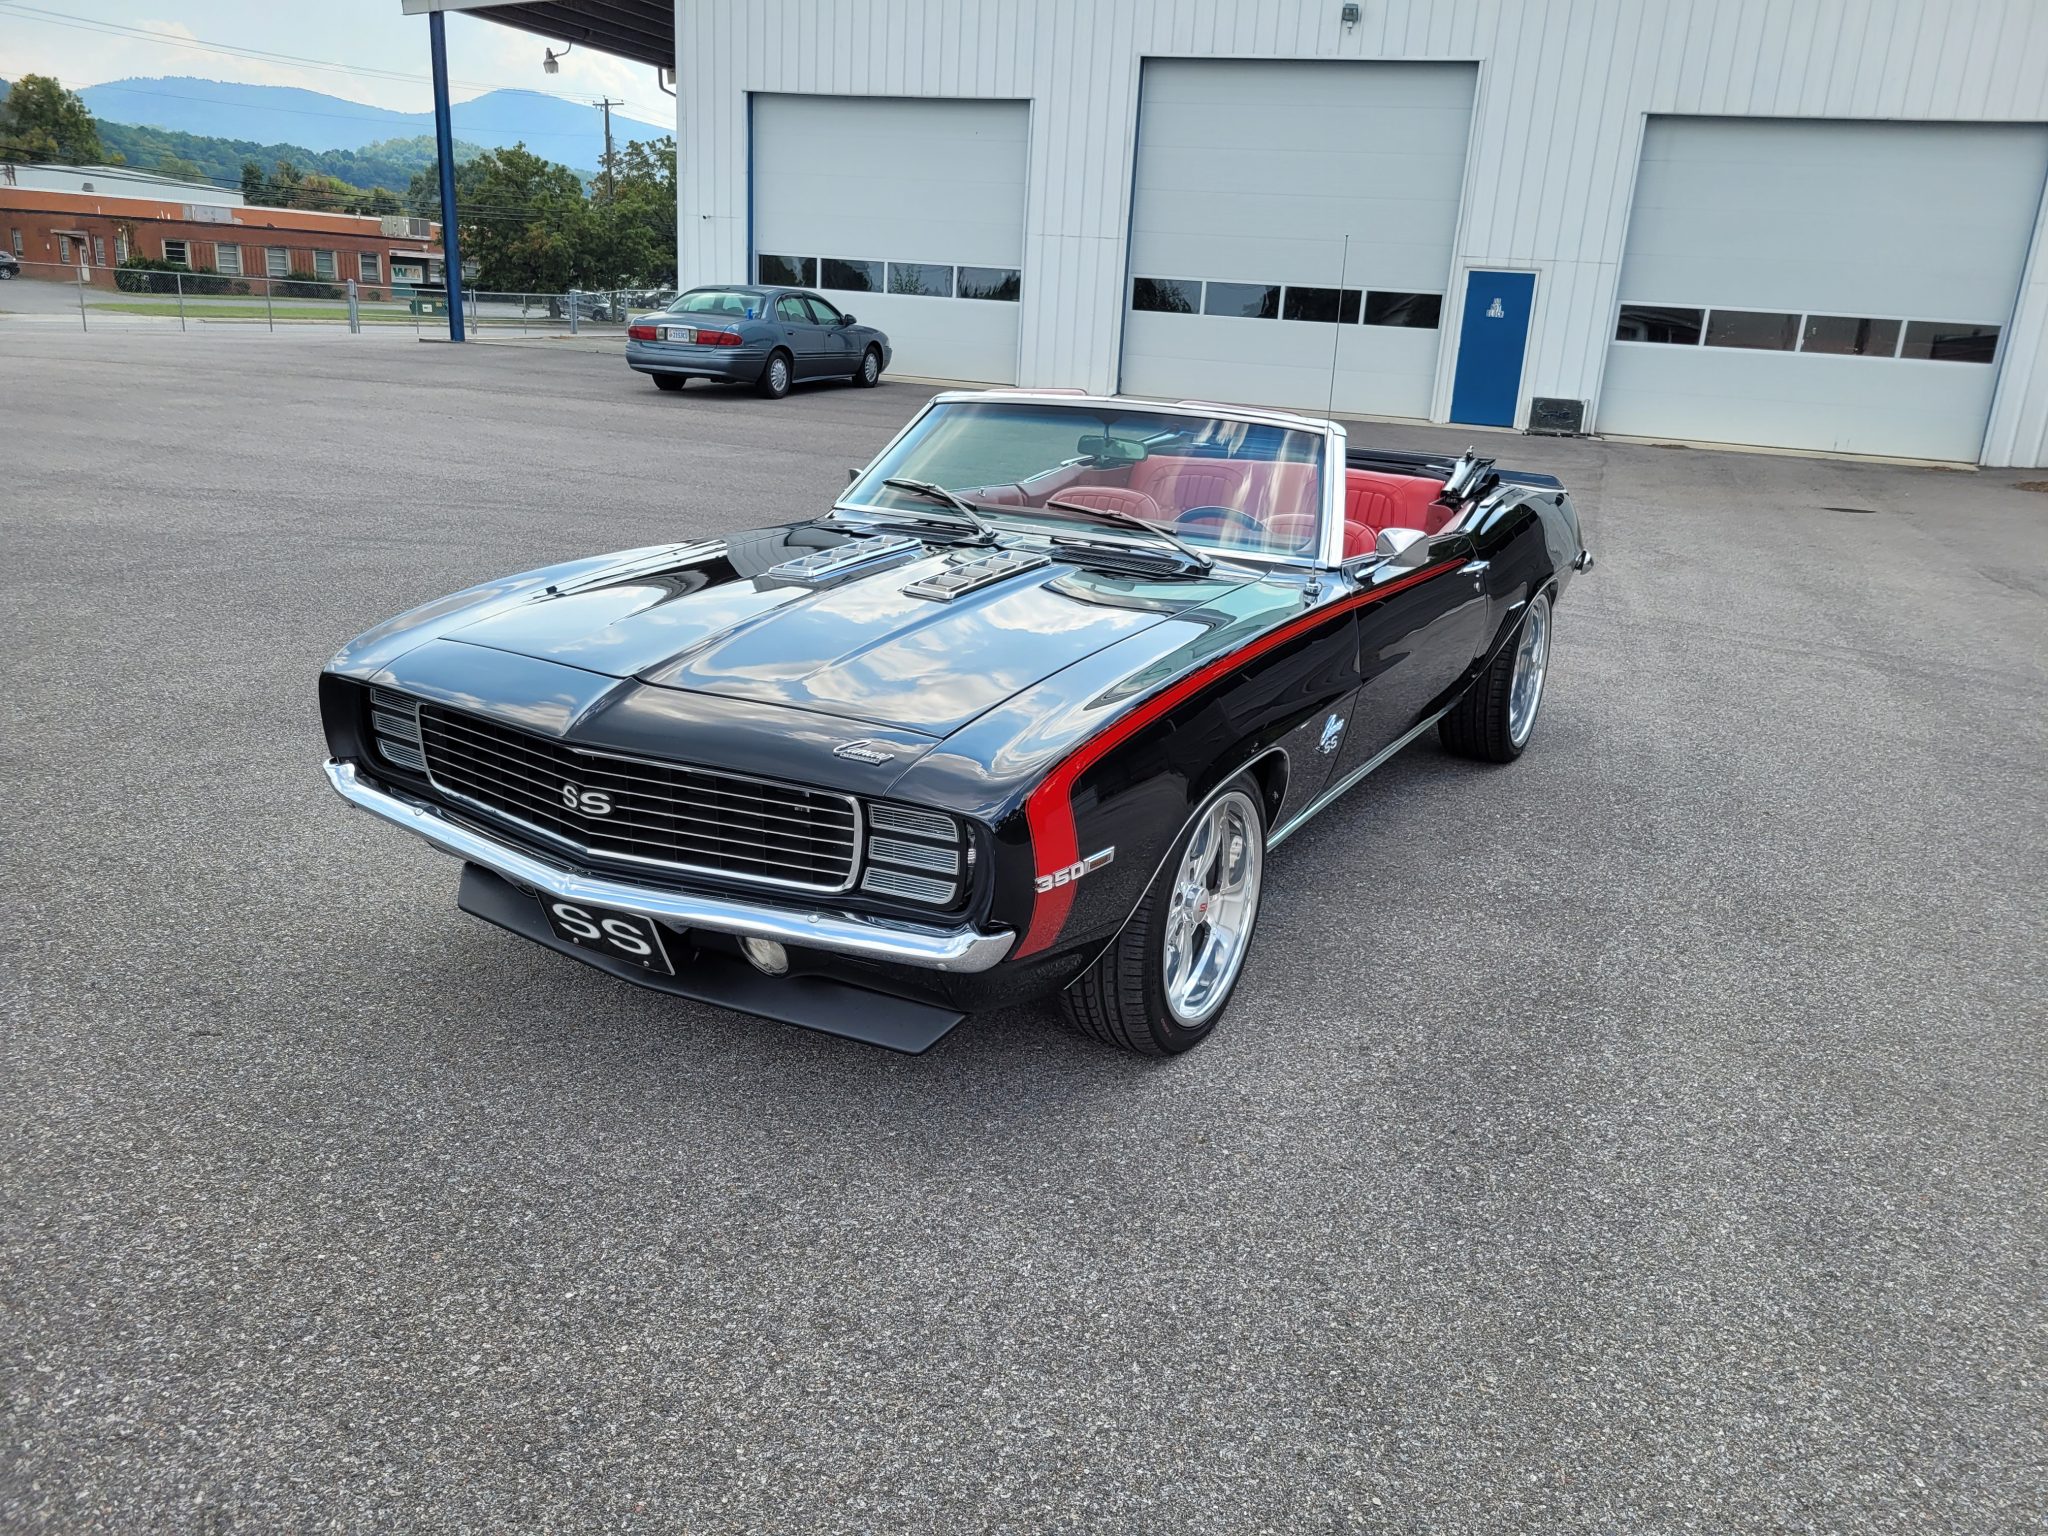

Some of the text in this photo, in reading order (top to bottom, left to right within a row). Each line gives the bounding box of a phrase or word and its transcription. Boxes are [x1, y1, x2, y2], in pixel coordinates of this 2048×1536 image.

[562, 783, 612, 815] SS
[1034, 861, 1085, 894] 350
[552, 903, 652, 955] SS
